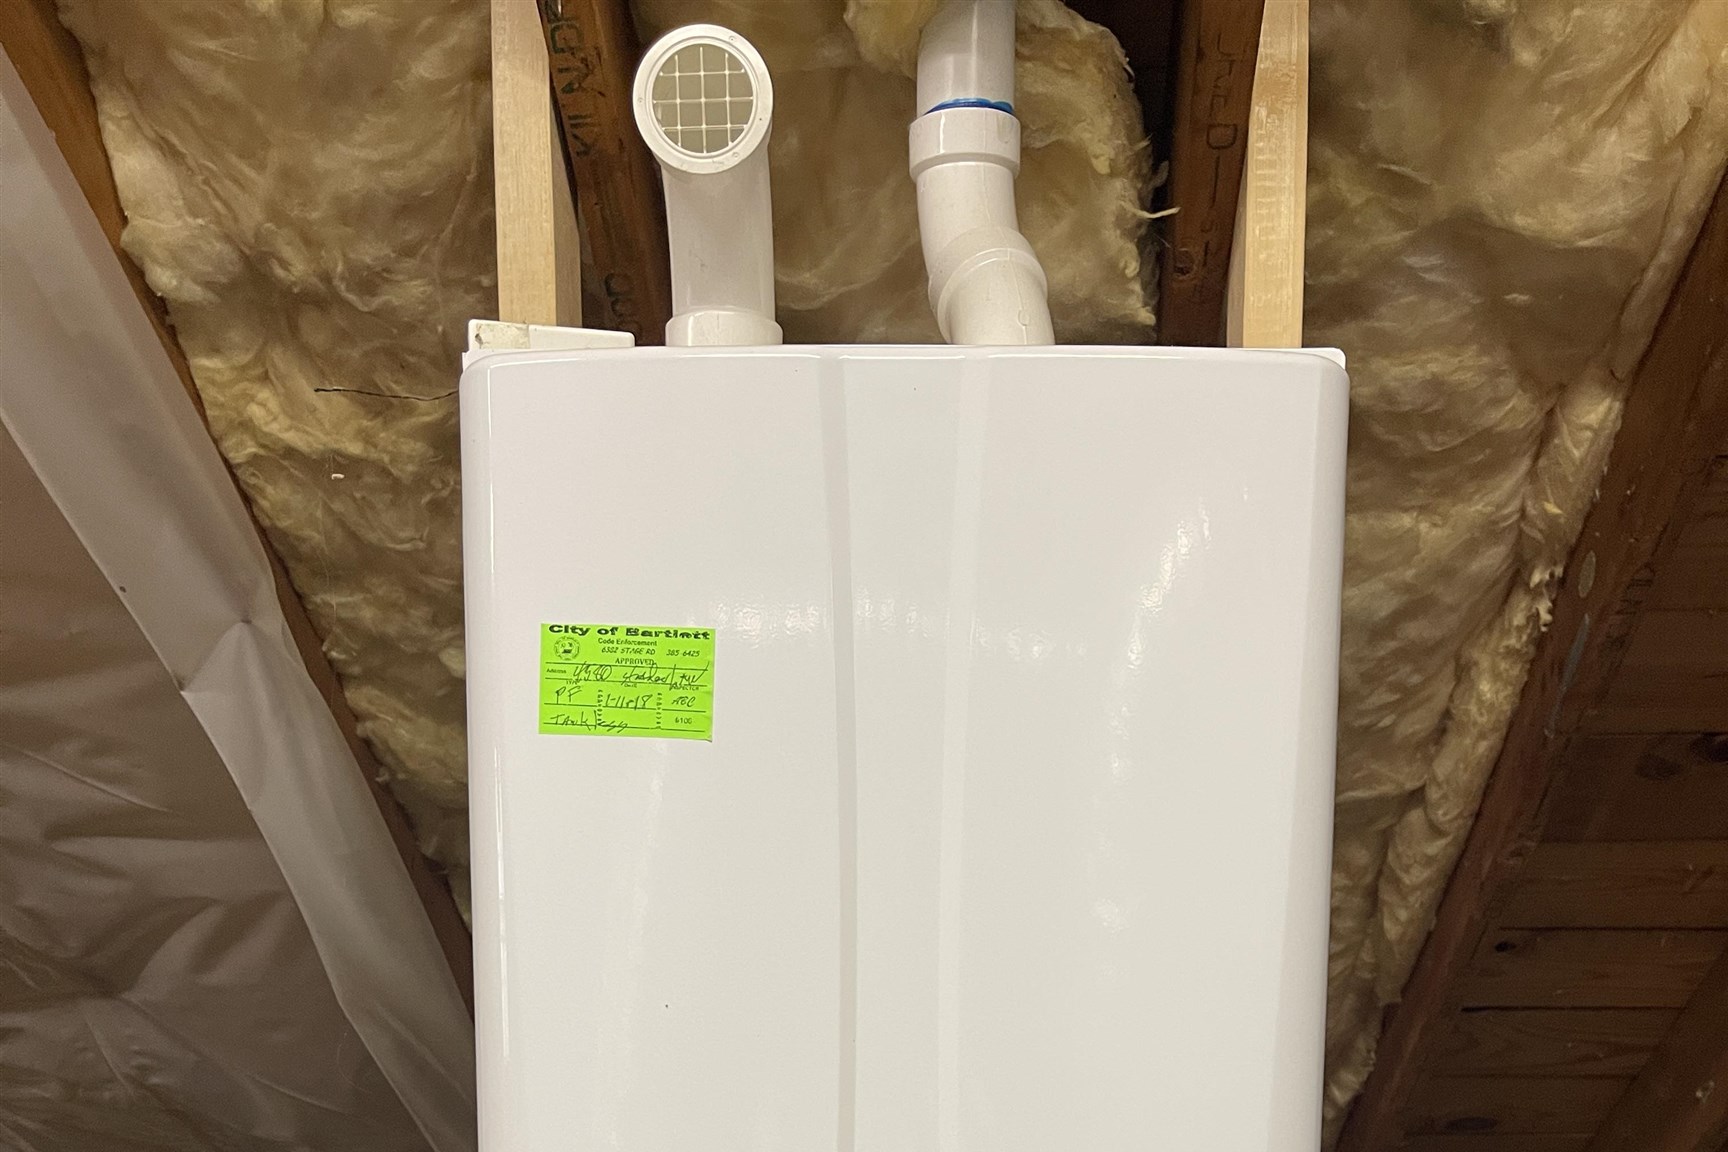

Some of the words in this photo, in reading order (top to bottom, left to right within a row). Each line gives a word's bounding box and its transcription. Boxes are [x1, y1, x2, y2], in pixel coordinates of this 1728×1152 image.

[549, 625, 591, 636] City
[597, 627, 618, 636] of
[625, 628, 710, 640] Bartlett
